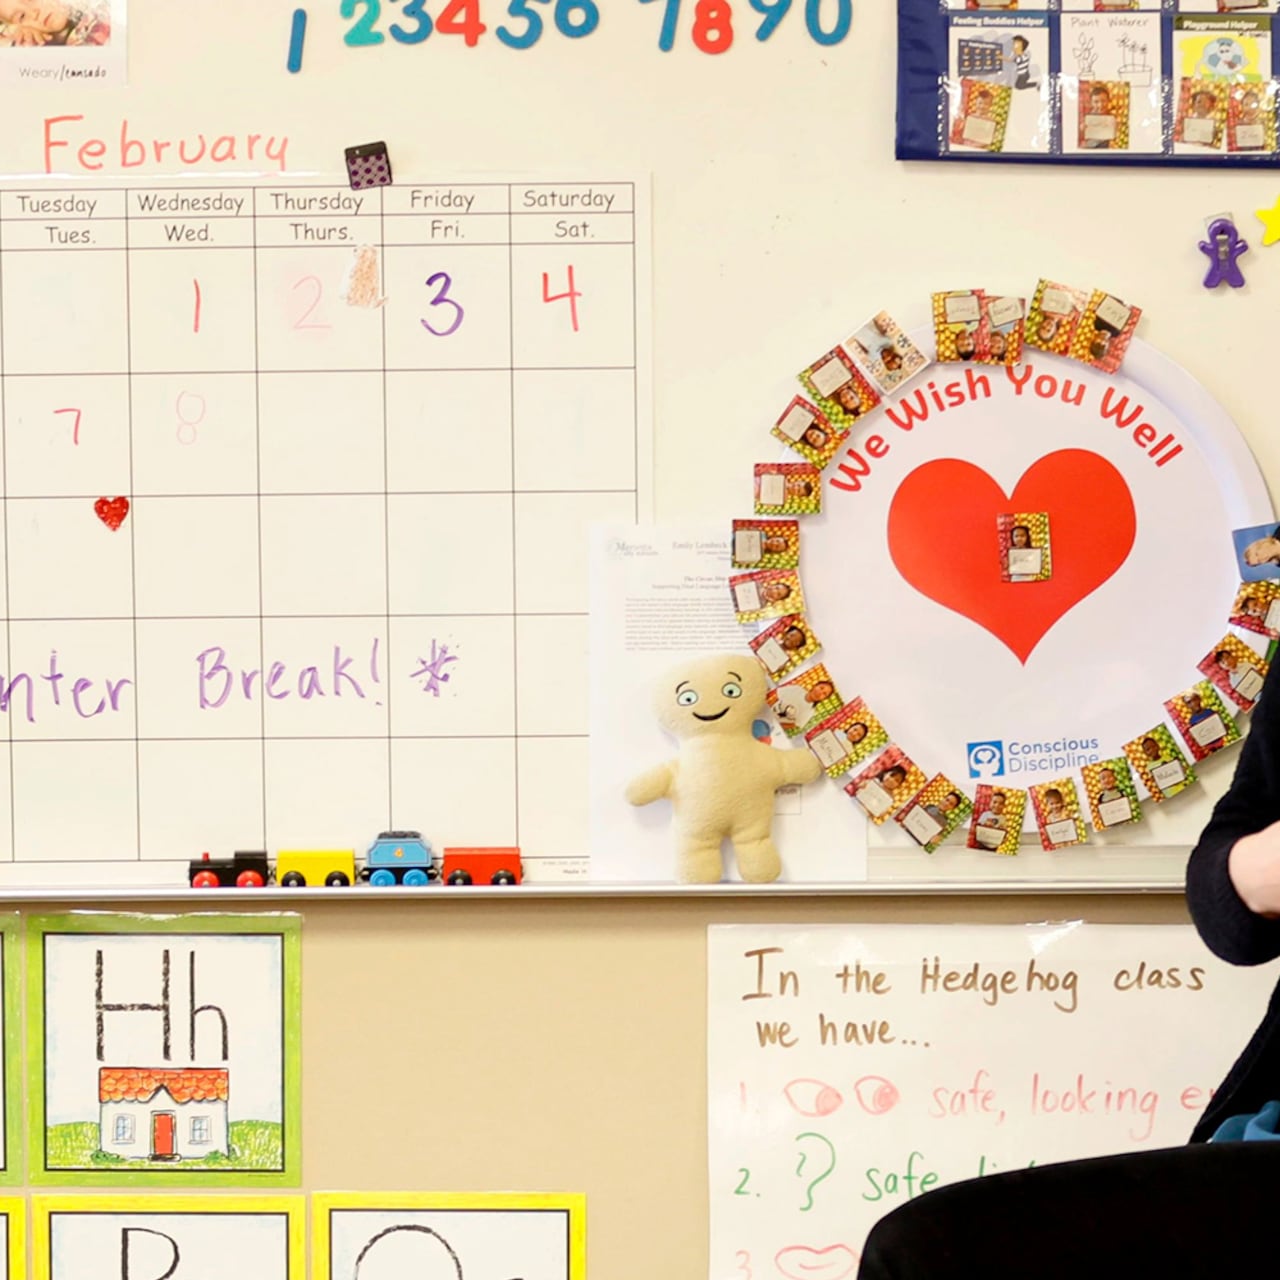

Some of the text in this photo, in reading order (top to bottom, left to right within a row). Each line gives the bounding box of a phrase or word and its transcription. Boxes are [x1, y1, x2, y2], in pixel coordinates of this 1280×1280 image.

[1017, 16, 1045, 27] Helper
[1071, 17, 1100, 27] Plant
[1231, 19, 1259, 31] Helper
[43, 114, 289, 174] February
[17, 194, 98, 218] Tuesday
[138, 192, 245, 217] Wednesday
[270, 192, 364, 216] Thursday
[410, 190, 476, 213] Friday
[523, 189, 615, 212] Saturday
[46, 226, 97, 245] Tues.
[165, 223, 215, 242] Wed.
[290, 222, 354, 241] Thurs.
[430, 221, 466, 239] Fri.
[555, 219, 596, 239] Sat.
[192, 265, 583, 336] 1 2 3 4
[53, 408, 82, 446] 7
[829, 364, 1183, 495] We Wish You Well
[195, 637, 383, 709] Break!
[1008, 736, 1099, 756] Conscious
[1008, 752, 1100, 773] Discipline
[742, 946, 1206, 1013] In the Hedgehog class
[95, 948, 229, 1062] Hh
[756, 1013, 931, 1049] we have...
[928, 1068, 1007, 1126] safe,
[1030, 1073, 1160, 1142] looking
[733, 1168, 761, 1197] 2.
[861, 1150, 939, 1202] safe
